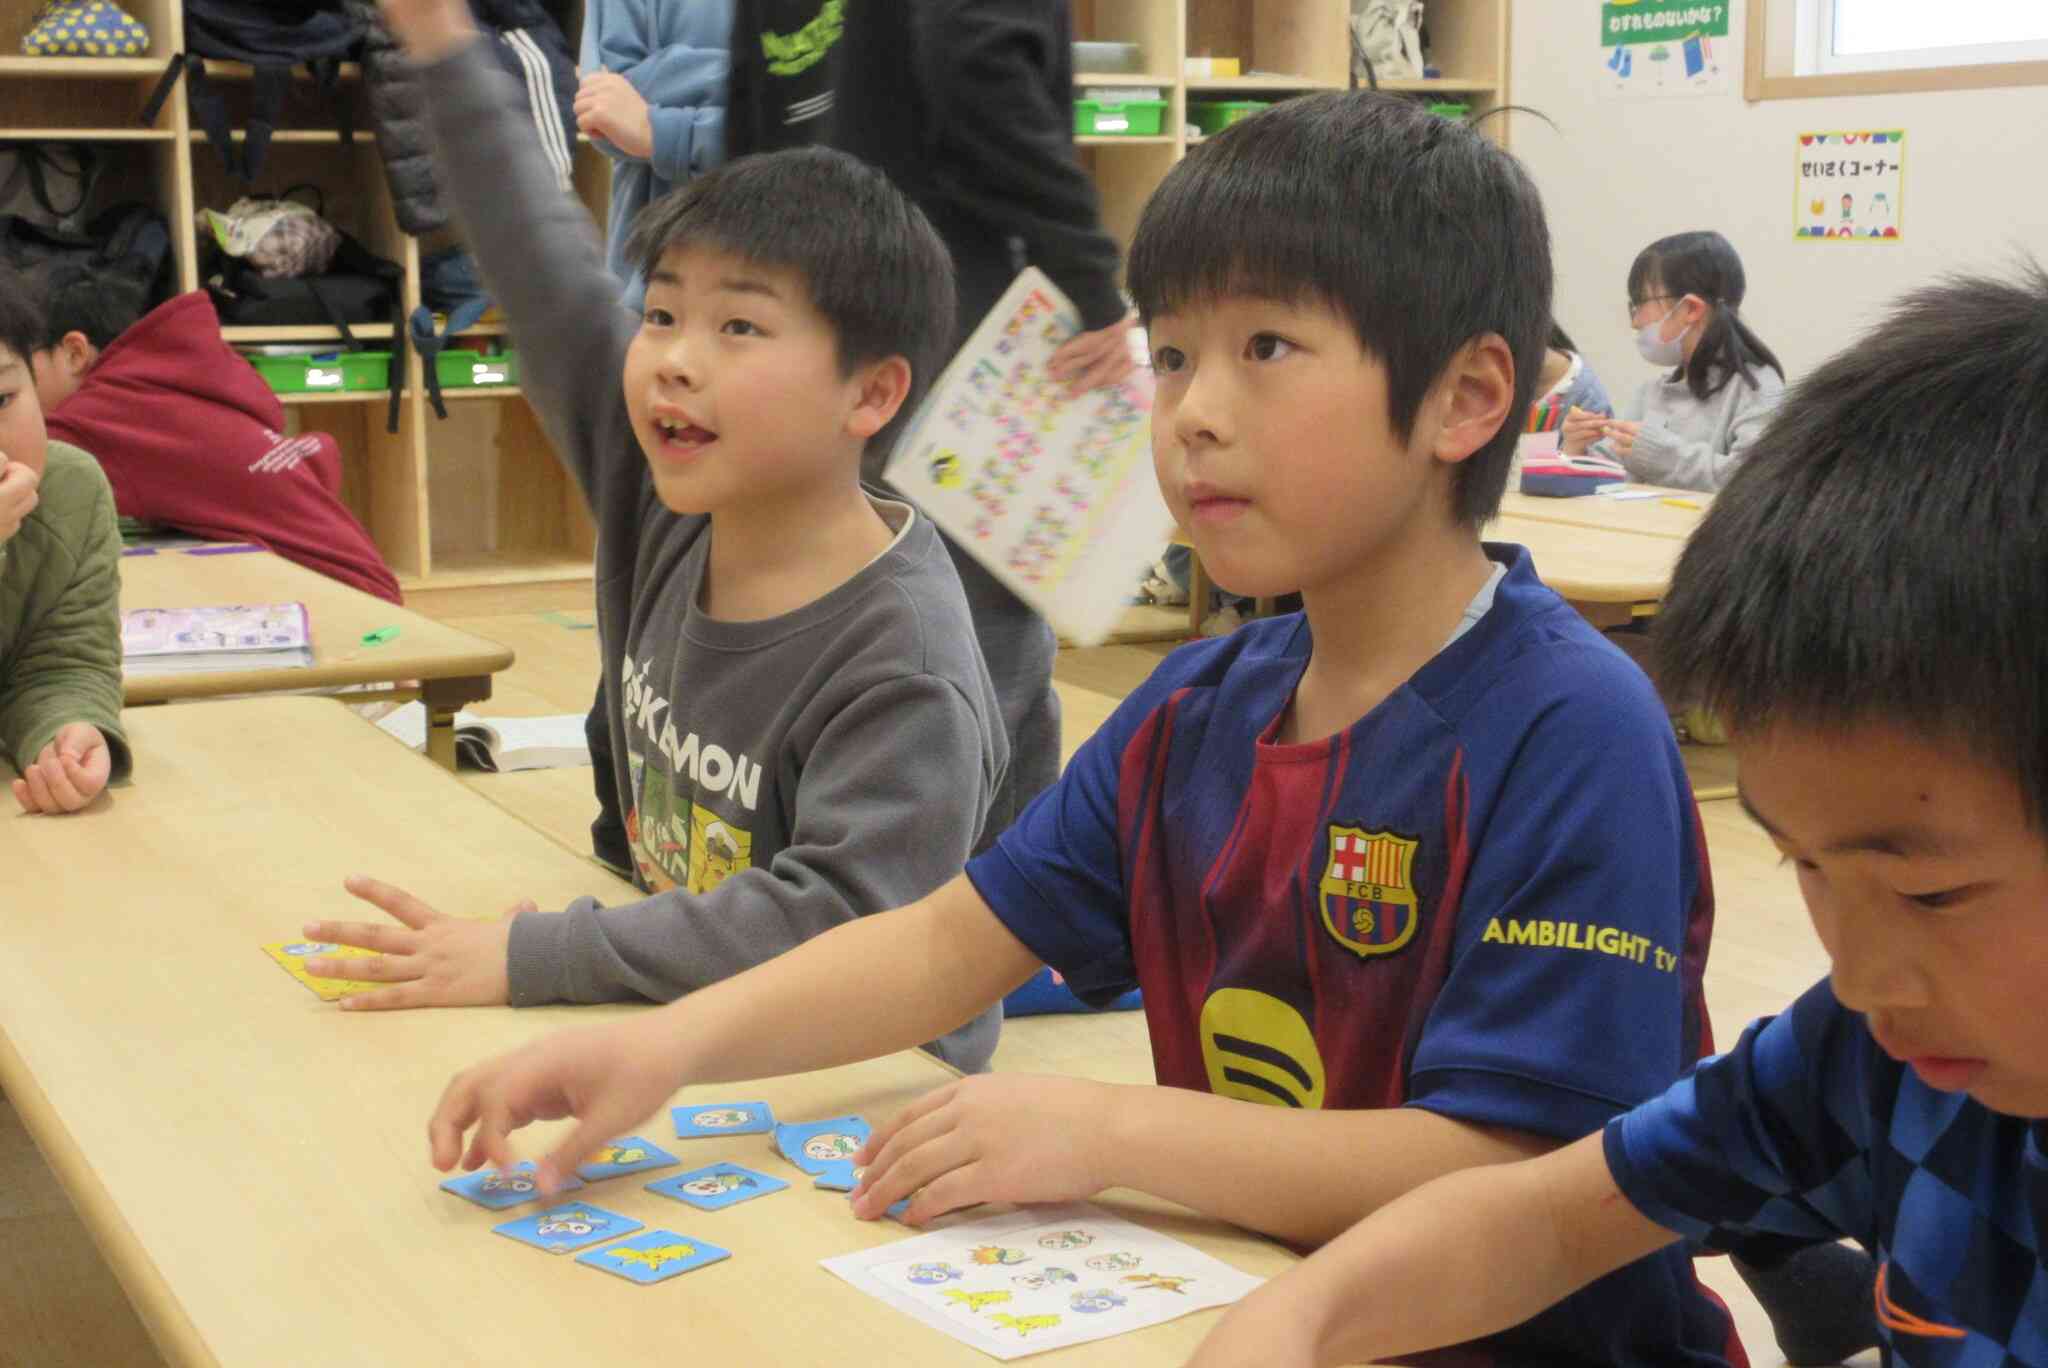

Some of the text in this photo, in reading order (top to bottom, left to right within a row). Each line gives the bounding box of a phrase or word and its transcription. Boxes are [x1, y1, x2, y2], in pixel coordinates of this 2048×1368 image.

[1802, 159, 1899, 177] せいさくコーナー
[1481, 918, 1678, 973] AMBILIGHT tv
